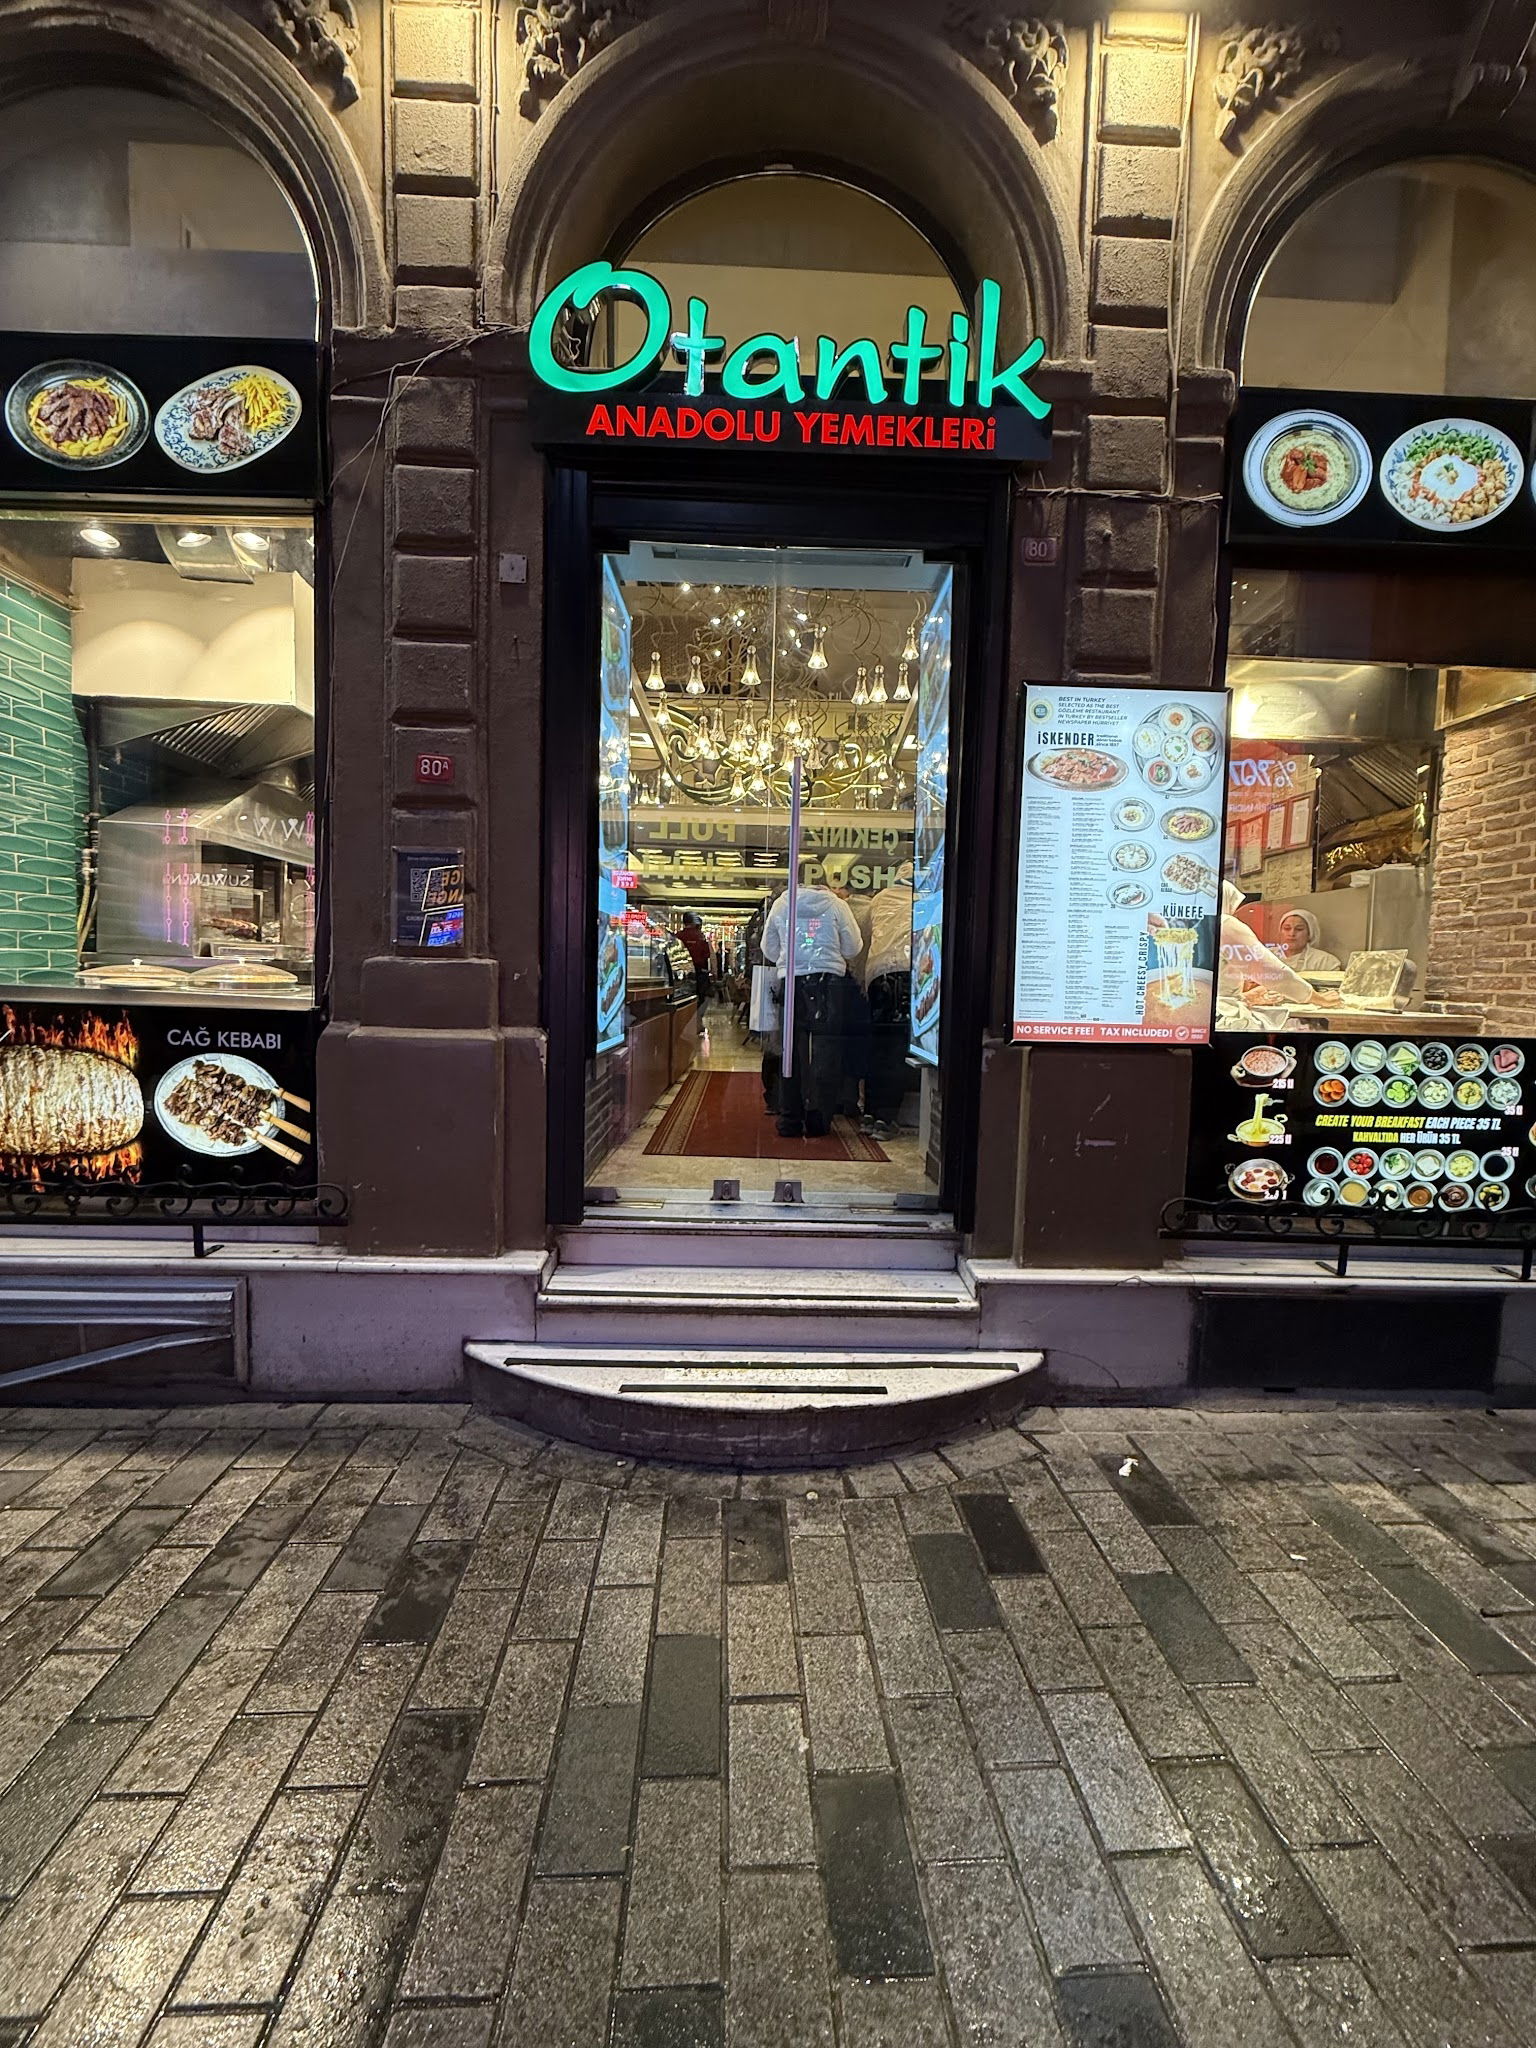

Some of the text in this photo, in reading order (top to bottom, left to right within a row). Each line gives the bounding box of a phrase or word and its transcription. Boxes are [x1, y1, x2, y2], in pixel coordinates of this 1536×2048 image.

[528, 260, 1053, 420] Otantik
[586, 404, 782, 443] ANADOLU
[1029, 541, 1047, 557] 80
[804, 863, 896, 890] PUSH
[1162, 903, 1204, 918] KÜNEFE
[1135, 931, 1148, 1015] HOT CHEESY CRISPY
[167, 1026, 281, 1049] CAĞ KEBABI
[1016, 1025, 1173, 1038] NO SERVICE FEE! TAX INCLUDED!
[1504, 1105, 1515, 1115] 35
[1315, 1115, 1350, 1127] CREATE
[1350, 1115, 1375, 1127] YOUR
[1374, 1116, 1426, 1128] BREAKFAST
[1425, 1117, 1450, 1129] EACH
[1450, 1117, 1476, 1130] PIECE
[1476, 1118, 1490, 1130] 35
[1269, 1134, 1284, 1144] 225
[1400, 1132, 1416, 1143] HER
[1439, 1133, 1451, 1145] 35
[1501, 1147, 1512, 1156] 35
